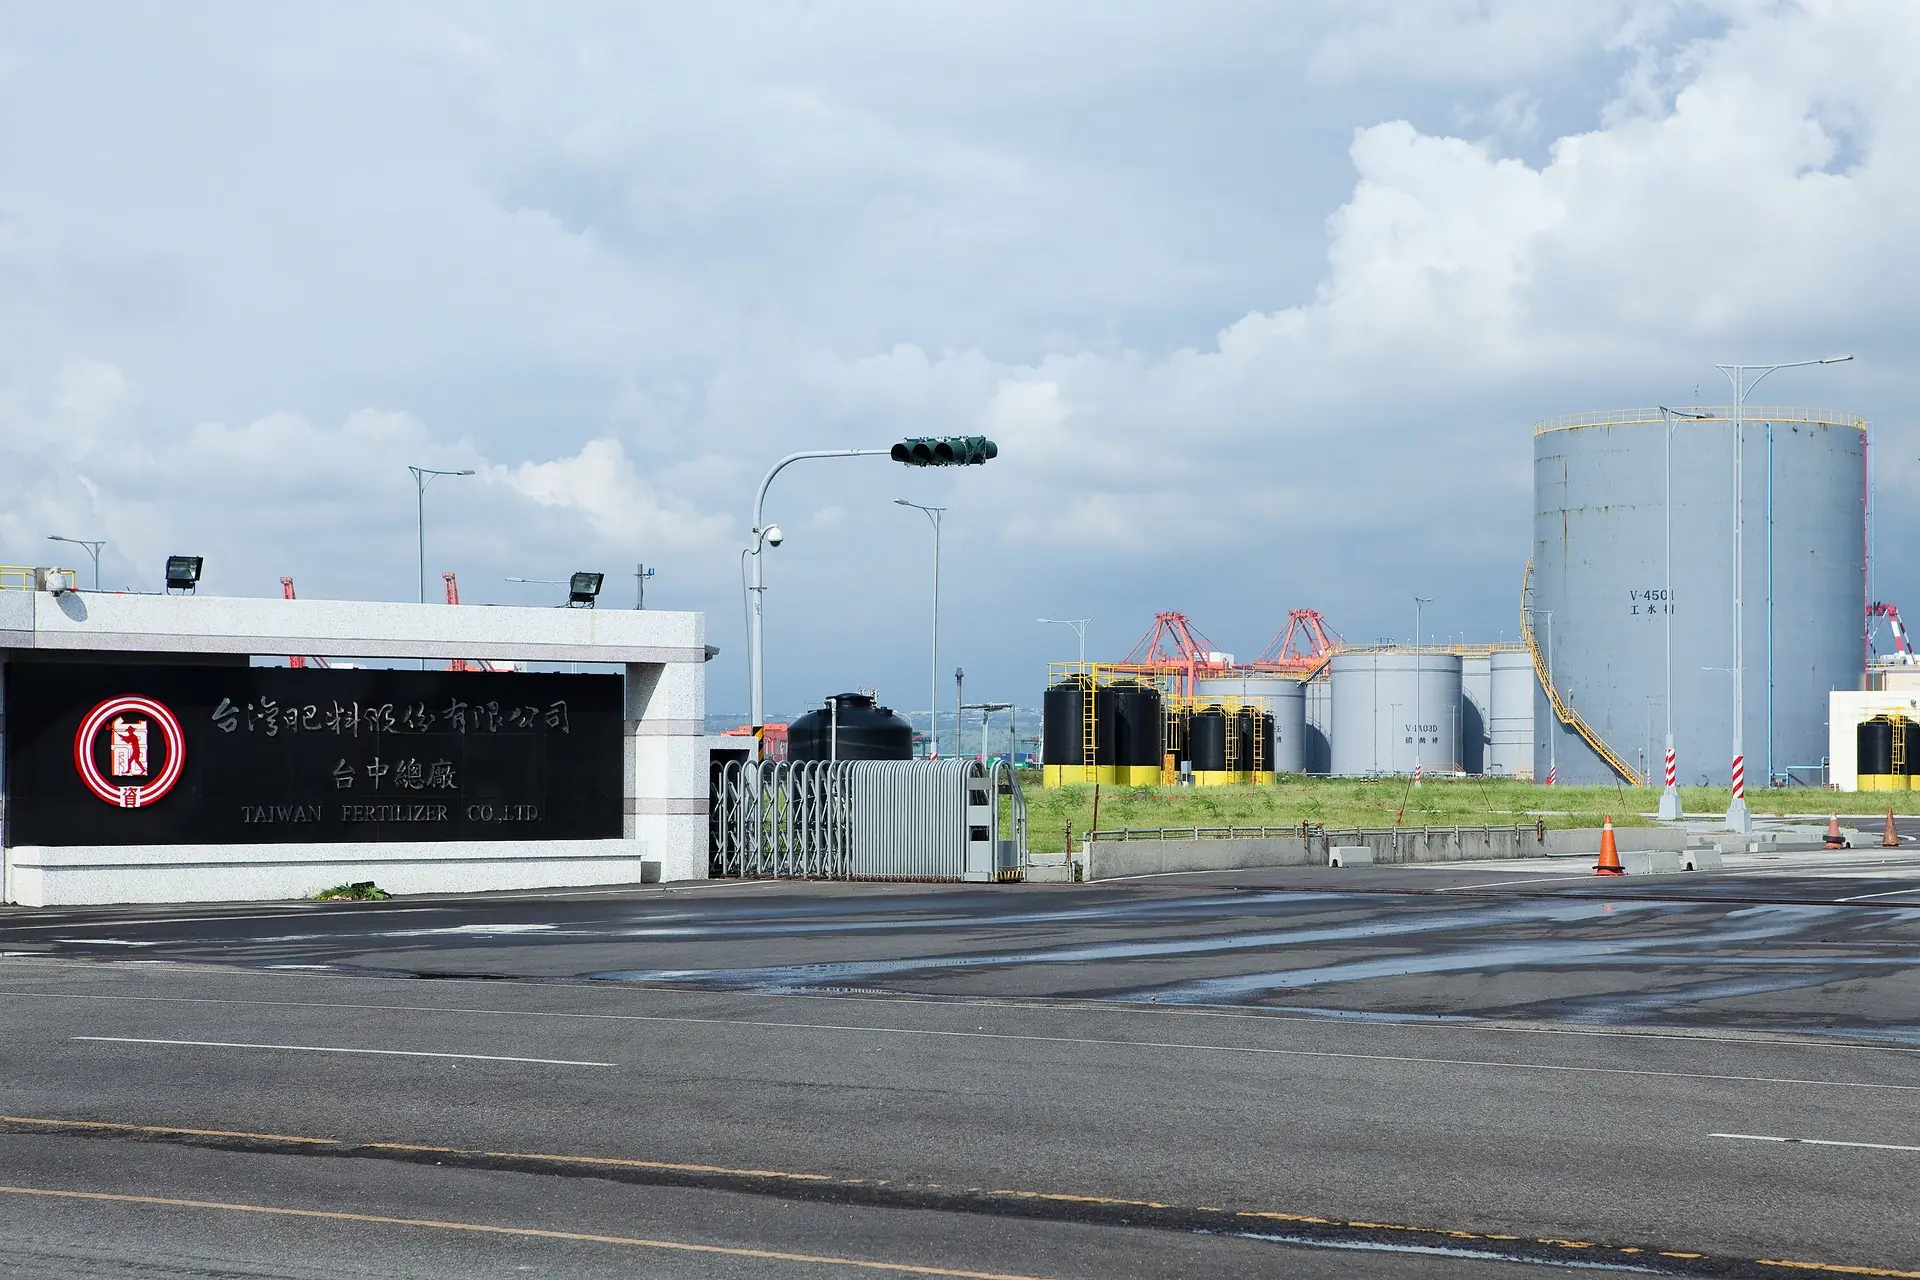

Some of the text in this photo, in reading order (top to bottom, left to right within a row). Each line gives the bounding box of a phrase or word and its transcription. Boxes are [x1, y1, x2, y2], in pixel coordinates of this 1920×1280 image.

[211, 695, 570, 738] 台灣肥料股份有限公司
[332, 757, 459, 790] 台中總廠
[241, 805, 322, 823] TAIWAN
[341, 804, 449, 822] FERTILIZER
